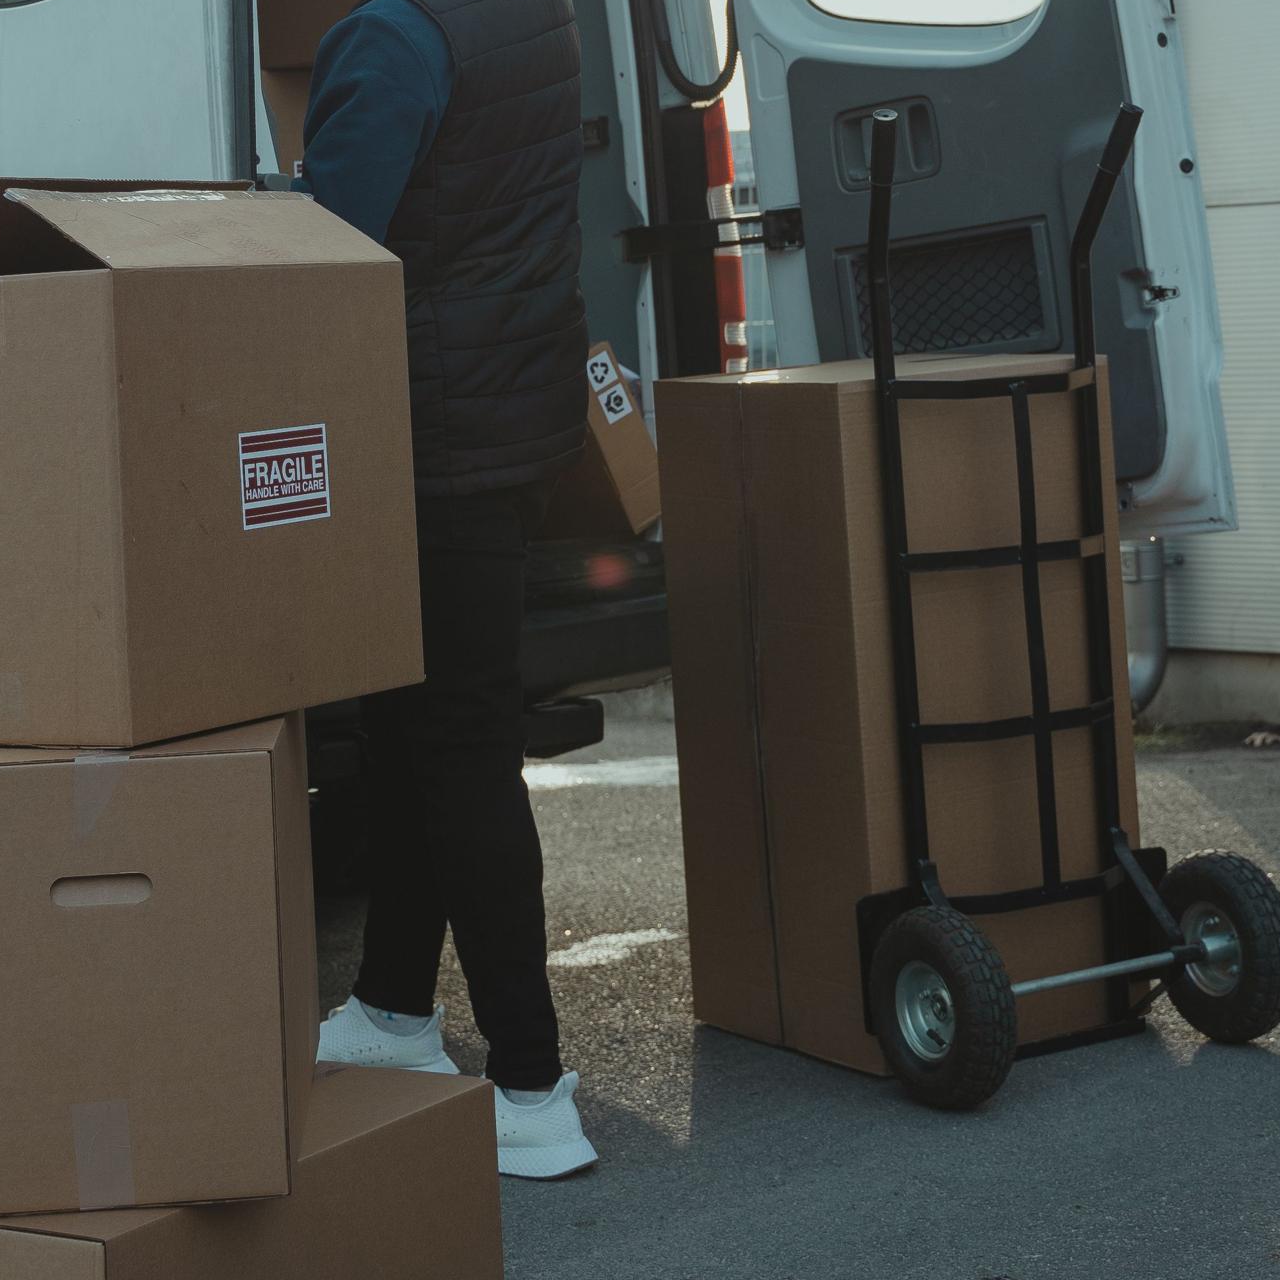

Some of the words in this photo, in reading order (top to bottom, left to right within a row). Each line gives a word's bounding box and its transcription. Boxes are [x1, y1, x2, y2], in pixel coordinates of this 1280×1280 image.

[244, 454, 323, 487] FRAGILE
[245, 486, 280, 500] HANDLE
[280, 482, 301, 495] WITH
[302, 479, 325, 492] CARE
